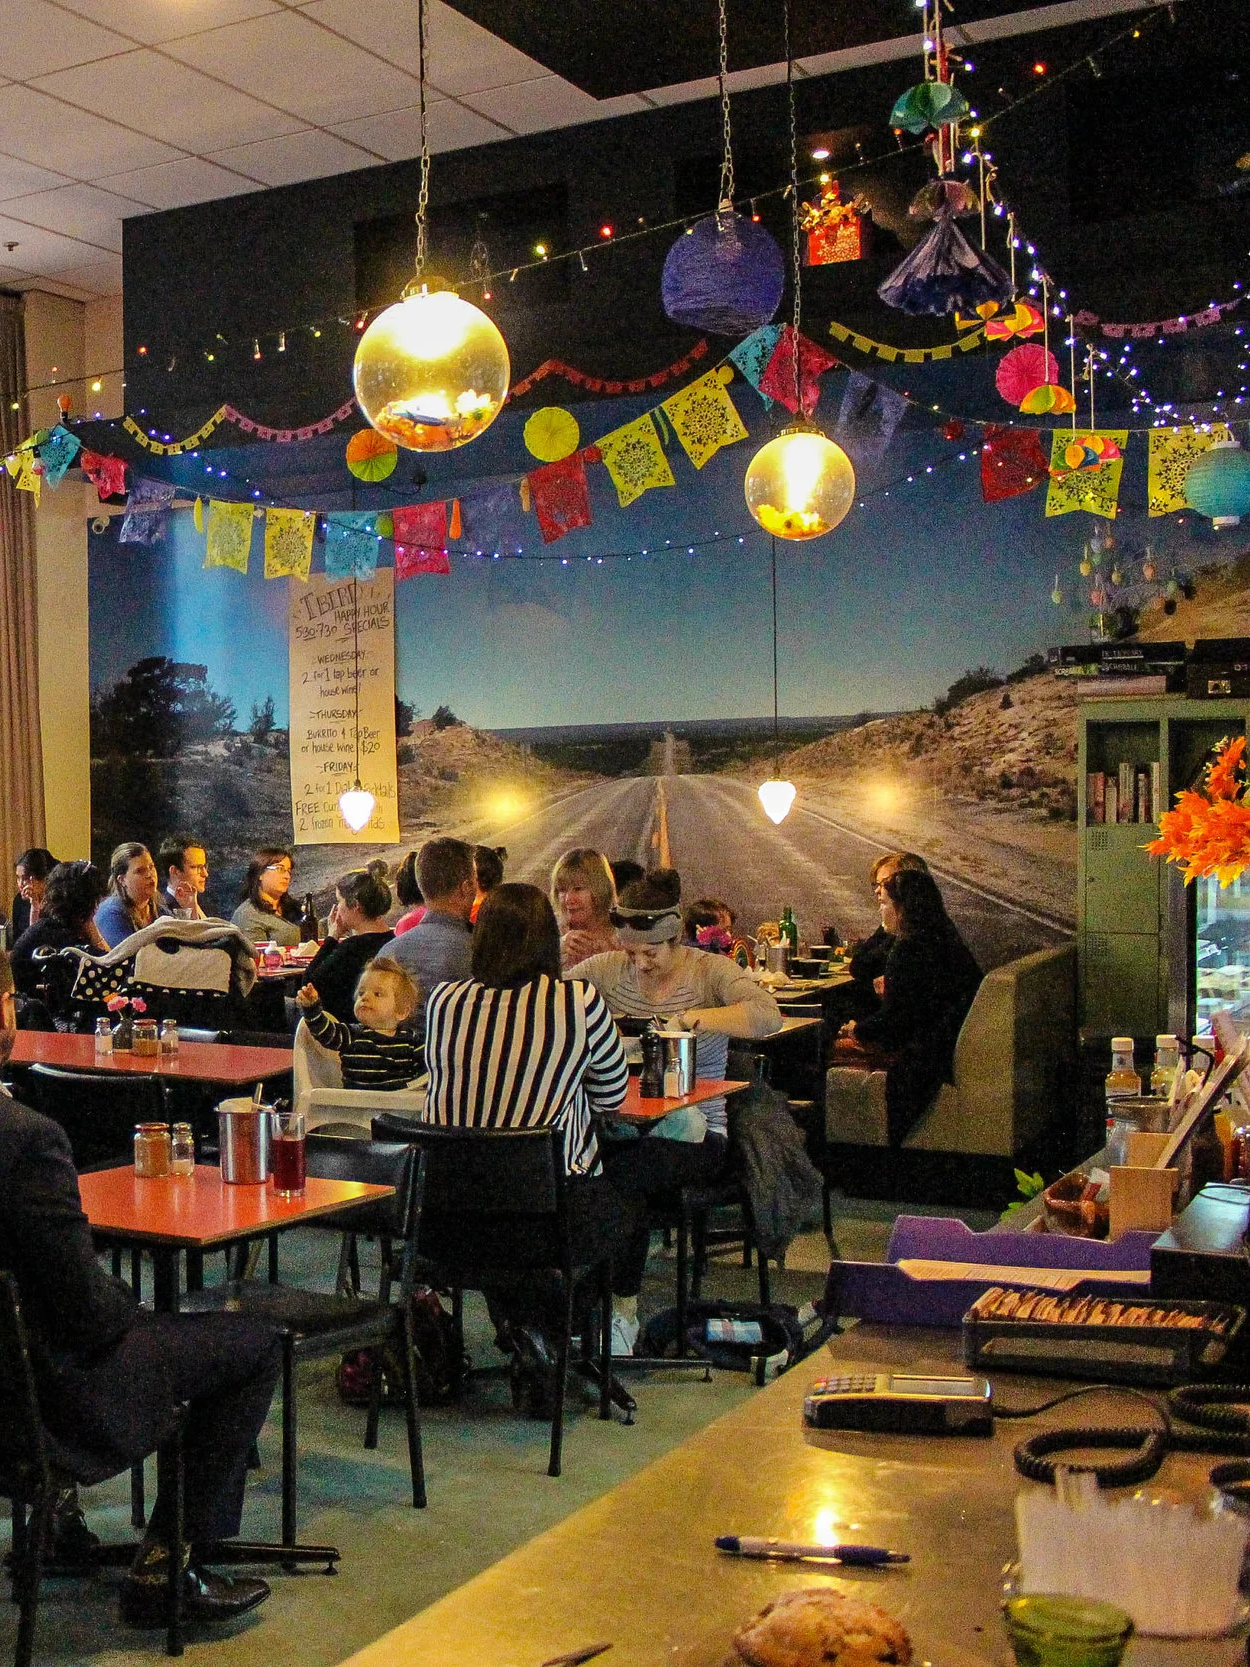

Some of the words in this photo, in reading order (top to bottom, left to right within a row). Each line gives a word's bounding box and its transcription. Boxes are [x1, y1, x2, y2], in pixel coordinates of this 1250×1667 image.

[363, 601, 390, 617] HOUR
[317, 650, 366, 665] WEDNESDAY
[301, 671, 311, 685] 2
[369, 667, 379, 677] or
[320, 685, 340, 698] house
[316, 709, 358, 720] THURSDAY
[306, 728, 338, 740] BURRITO
[301, 745, 309, 753] or
[312, 741, 334, 755] house
[336, 742, 355, 754] wine
[361, 740, 381, 755] $20
[323, 761, 354, 773] FRIDAY
[304, 783, 314, 796] 2
[295, 800, 320, 816] FREE
[299, 817, 310, 831] 2
